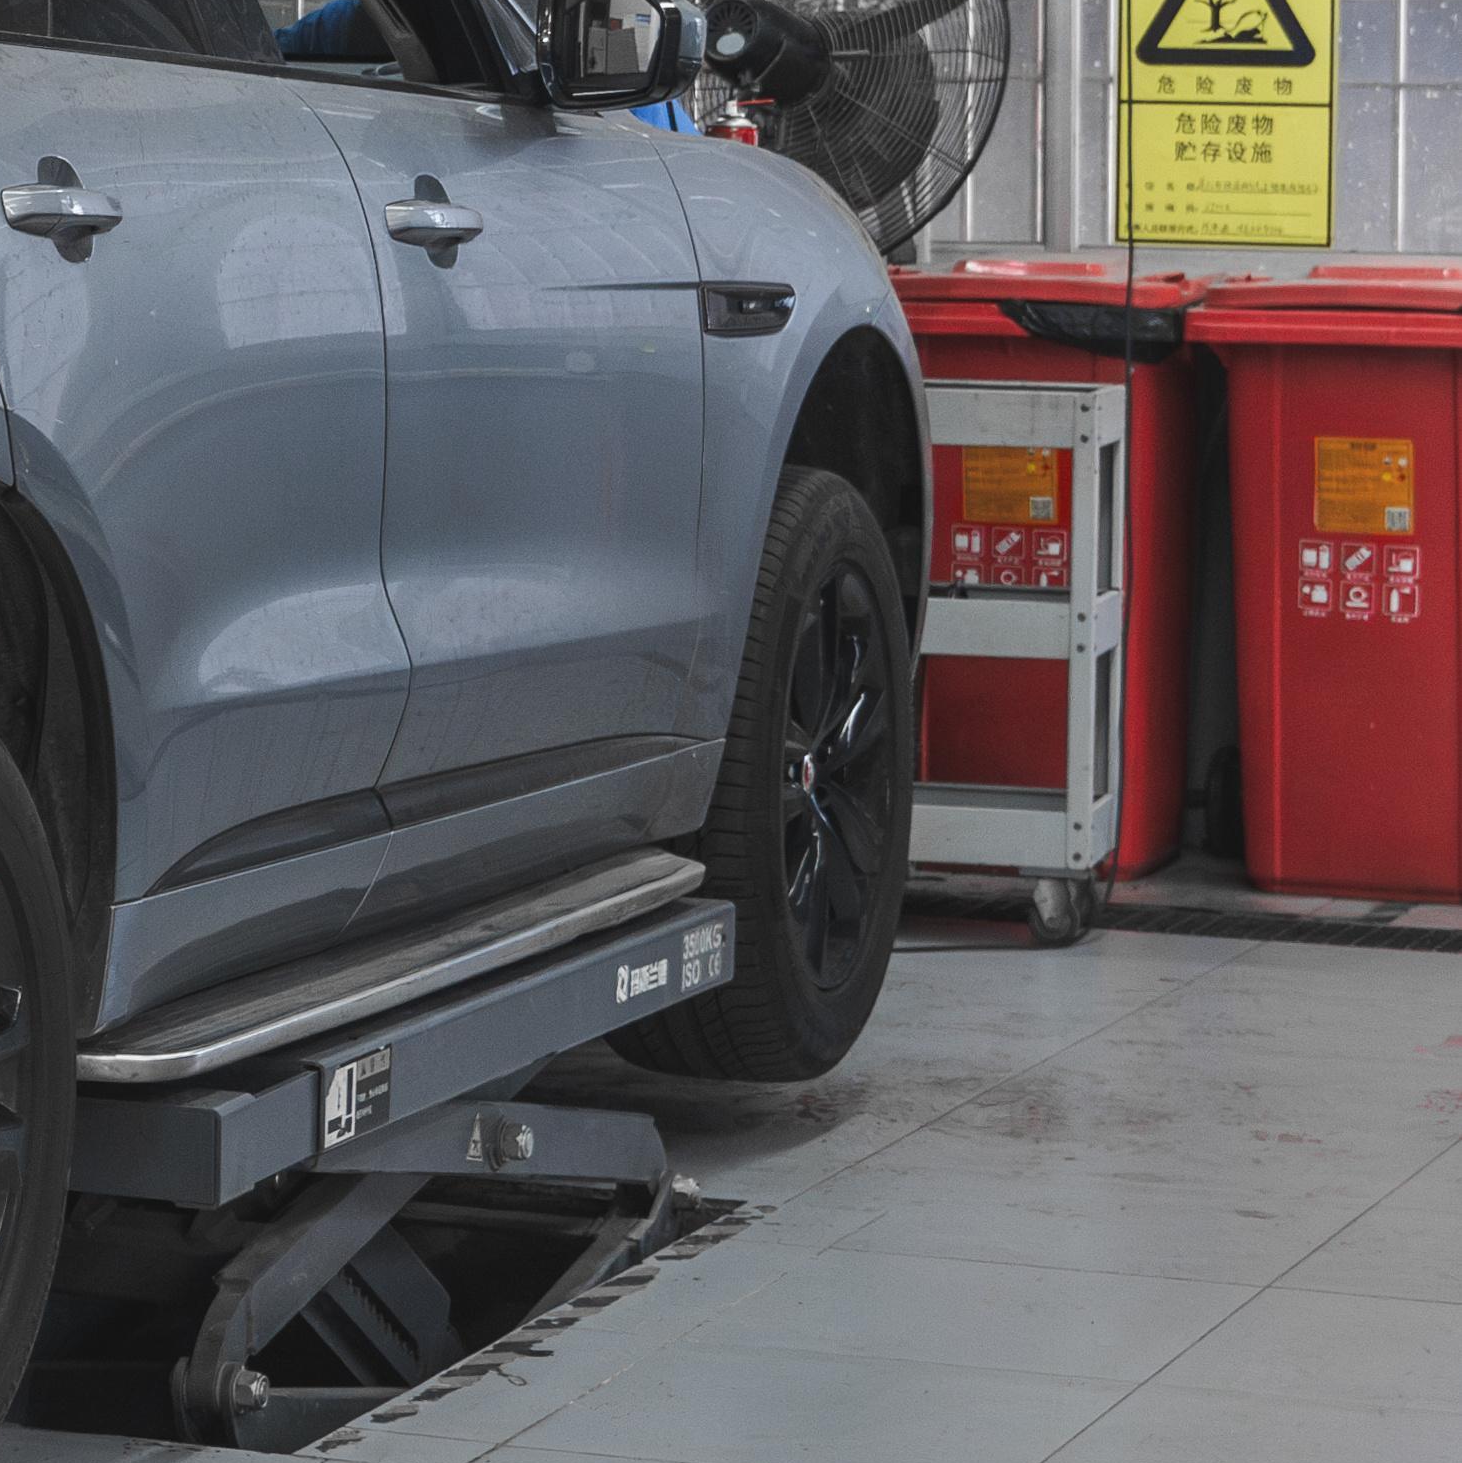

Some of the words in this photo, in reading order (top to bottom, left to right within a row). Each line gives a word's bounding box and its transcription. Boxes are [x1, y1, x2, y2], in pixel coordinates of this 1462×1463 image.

[1157, 74, 1293, 96] 危险废物
[1175, 112, 1274, 136] 危险废物
[1174, 141, 1274, 165] 贮存设施
[682, 959, 701, 993] ISO
